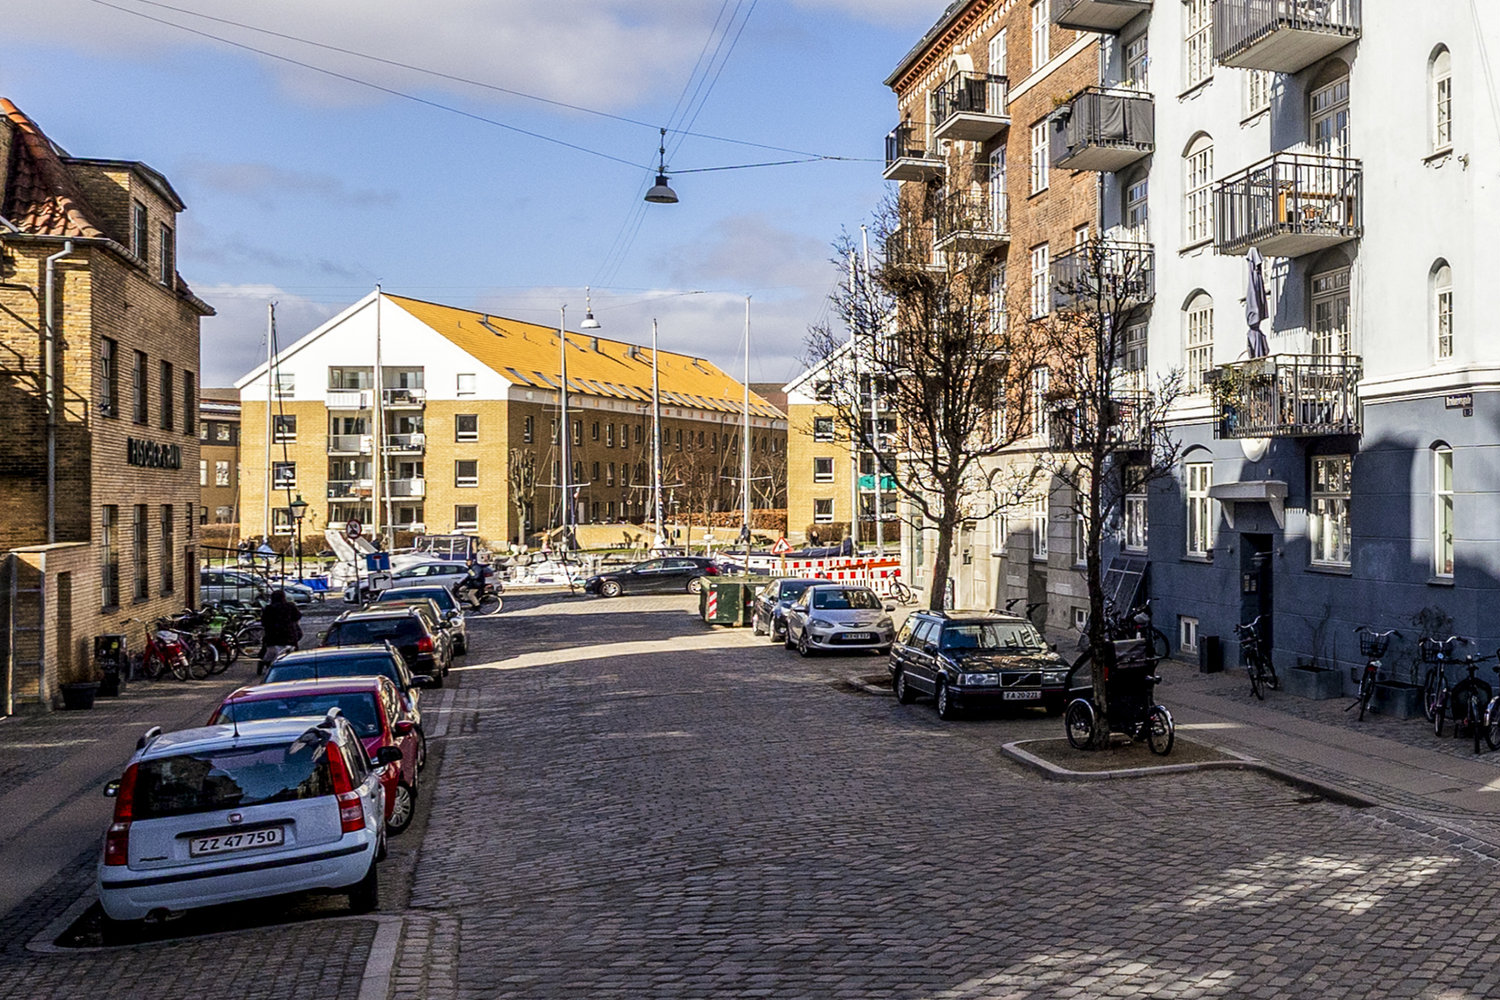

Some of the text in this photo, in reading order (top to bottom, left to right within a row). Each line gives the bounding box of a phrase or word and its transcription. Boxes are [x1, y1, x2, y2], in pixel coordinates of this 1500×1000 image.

[199, 830, 276, 852] ZZ 47 750
